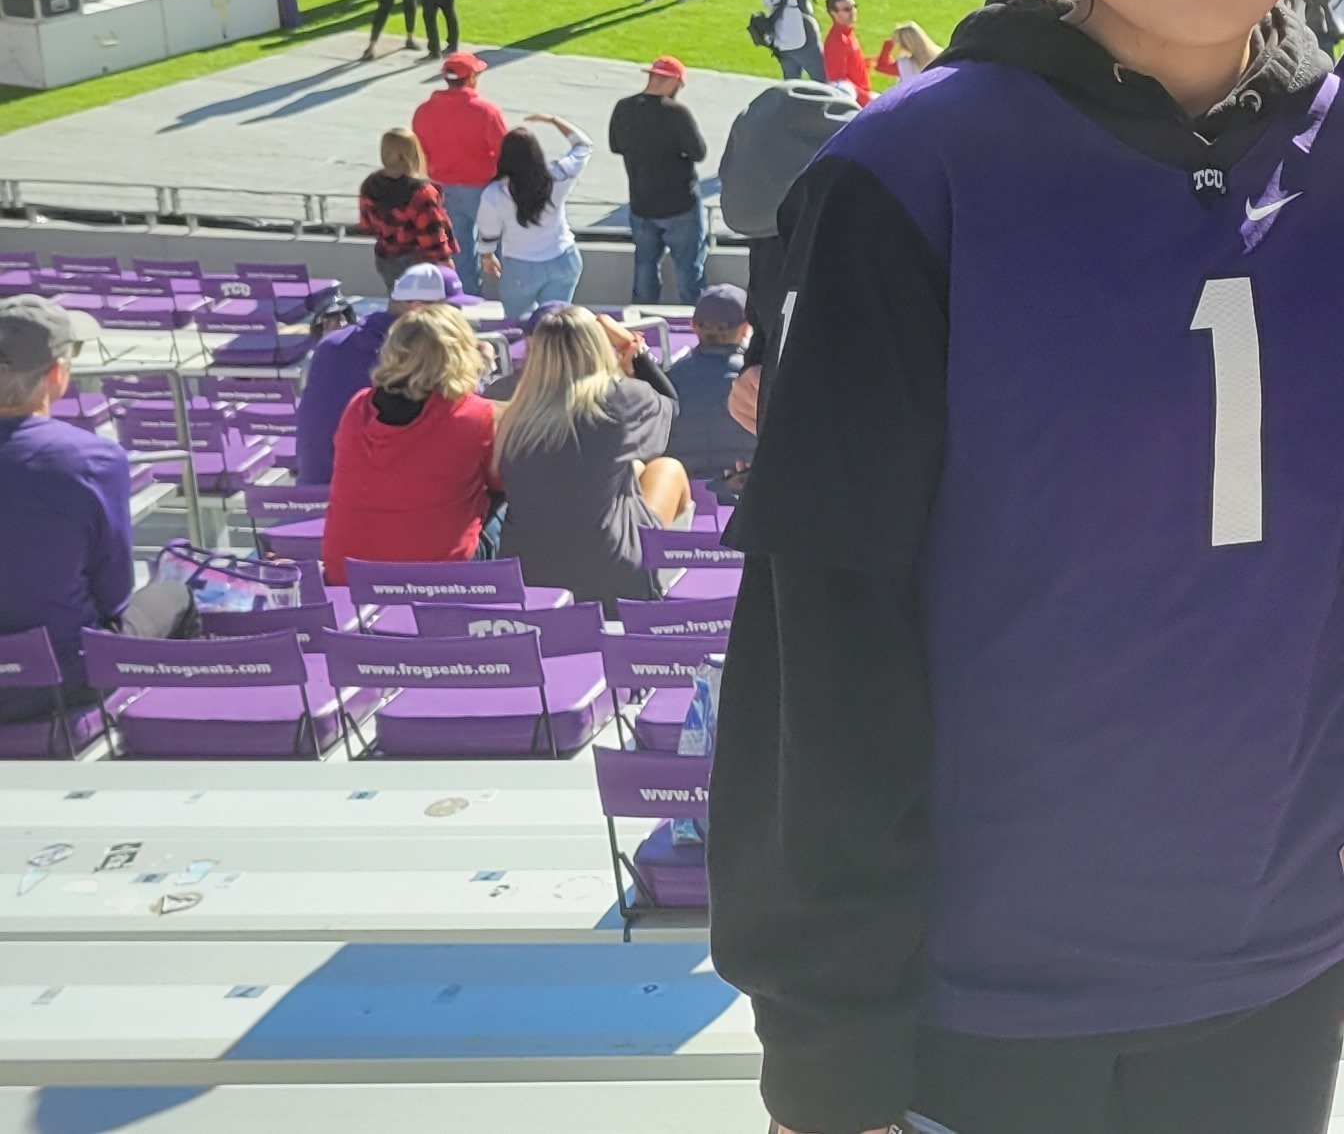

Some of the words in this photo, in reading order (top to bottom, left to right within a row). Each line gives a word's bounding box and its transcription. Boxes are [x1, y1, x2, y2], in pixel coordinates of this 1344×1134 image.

[1193, 168, 1223, 191] TCU
[1190, 276, 1263, 547] 1
[372, 583, 497, 598] www.frogseats.com
[116, 662, 272, 679] www.frogseats.com
[356, 663, 511, 680] www.frogseats.com
